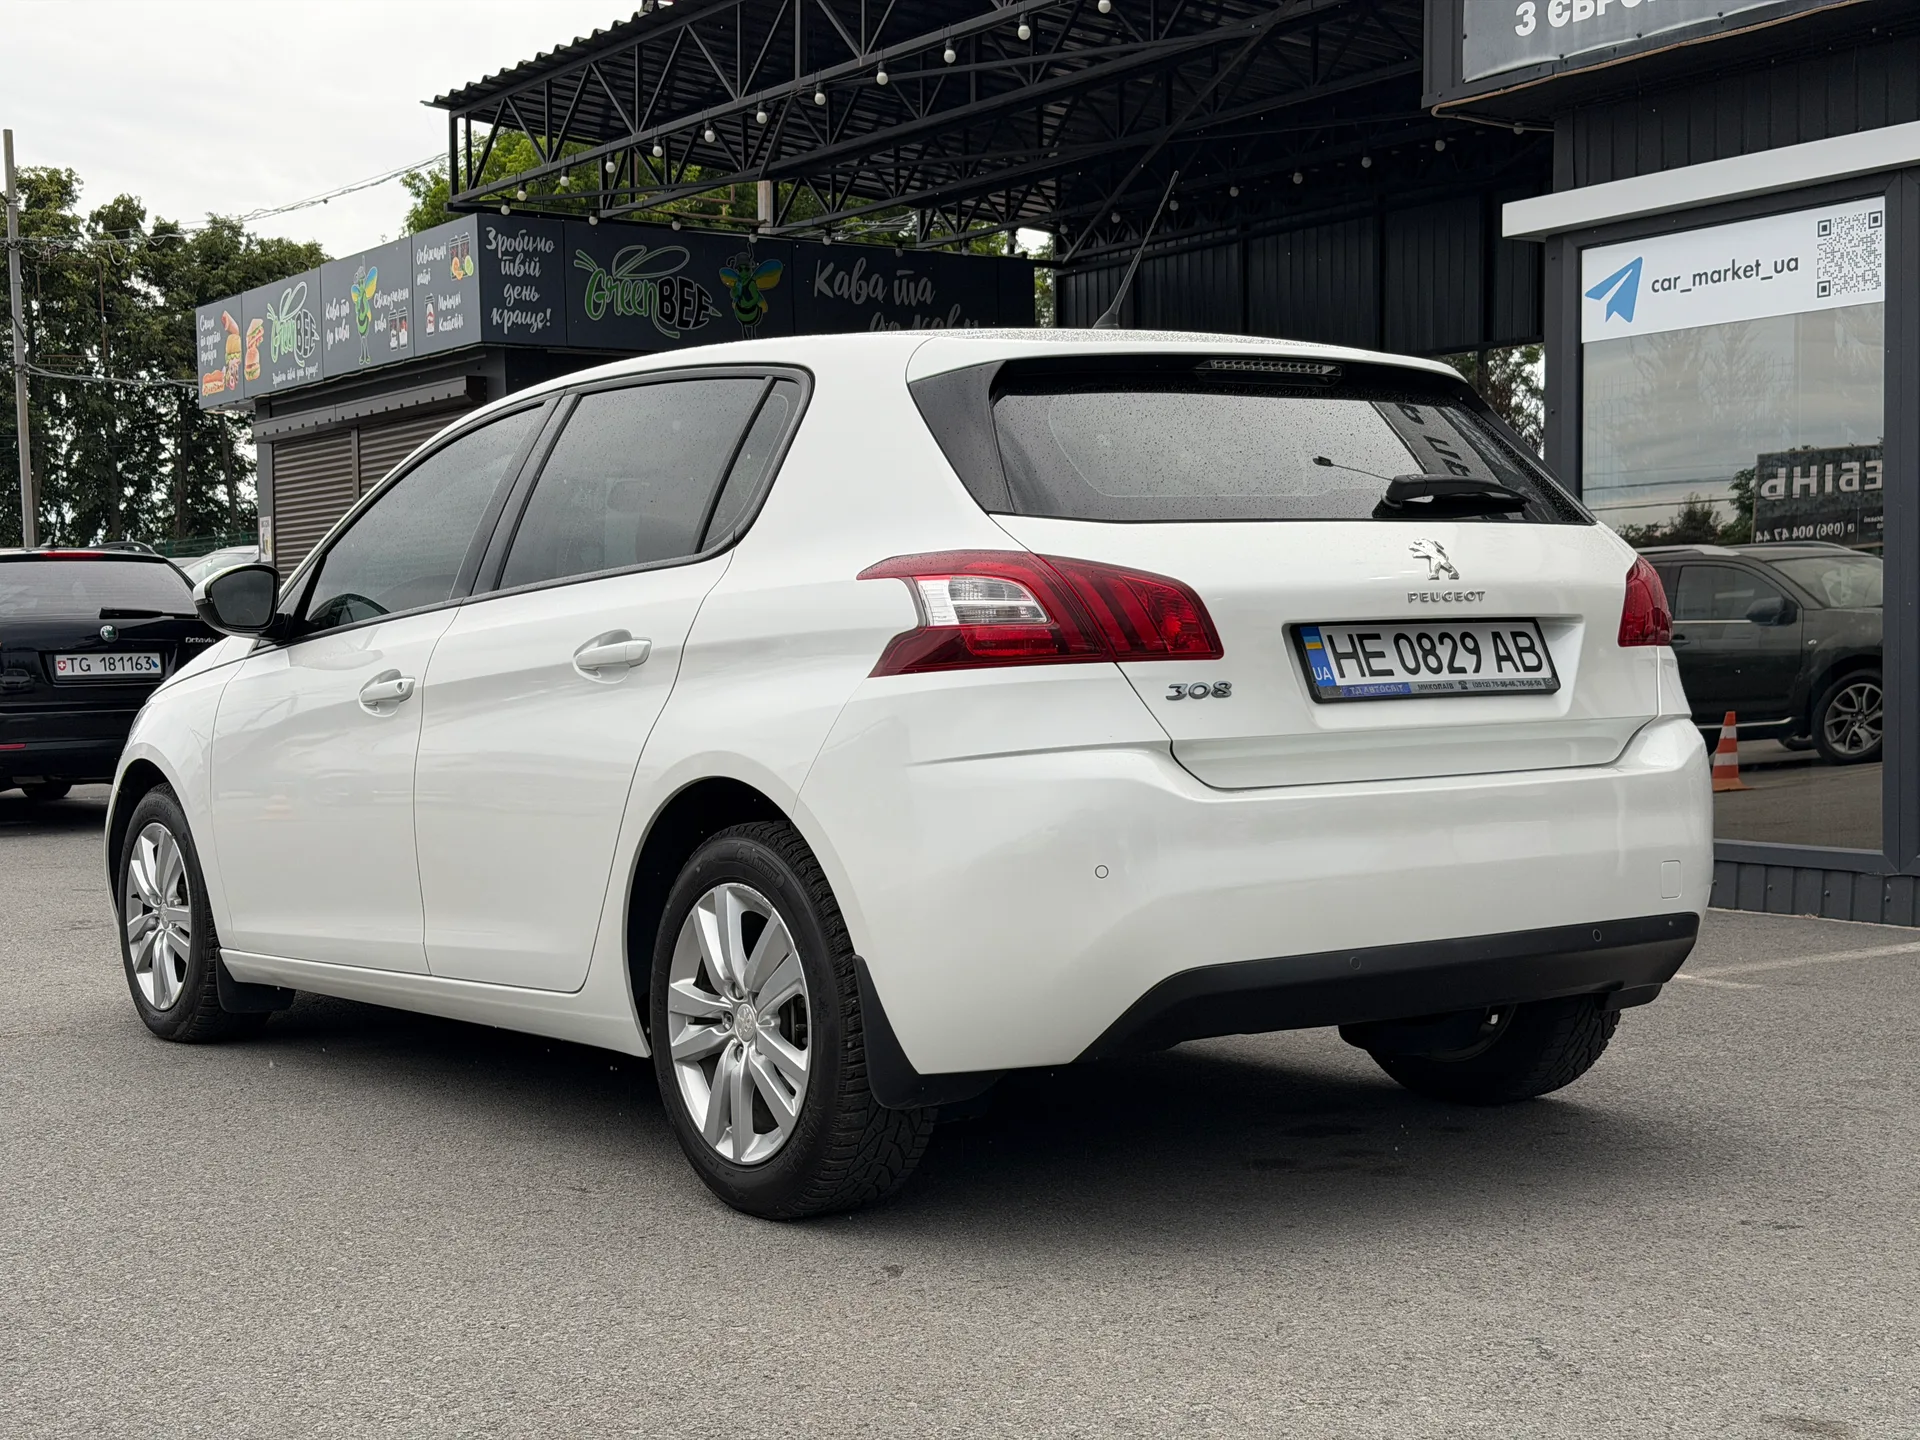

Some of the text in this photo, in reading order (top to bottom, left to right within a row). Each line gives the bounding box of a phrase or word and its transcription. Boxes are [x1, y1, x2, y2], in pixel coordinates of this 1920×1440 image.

[485, 226, 555, 259] Зробимо
[500, 252, 542, 277] твій
[1651, 256, 1800, 294] car_market_ua
[813, 256, 936, 307] Кава та
[503, 283, 541, 306] день
[490, 307, 552, 335] краще!
[1407, 590, 1486, 603] PEUGEOT
[66, 656, 152, 673] TG 181163
[1393, 631, 1482, 676] 0829
[1312, 666, 1333, 682] UA
[1417, 680, 1455, 691] МИКОЛАЇВ
[1165, 681, 1232, 701] 308
